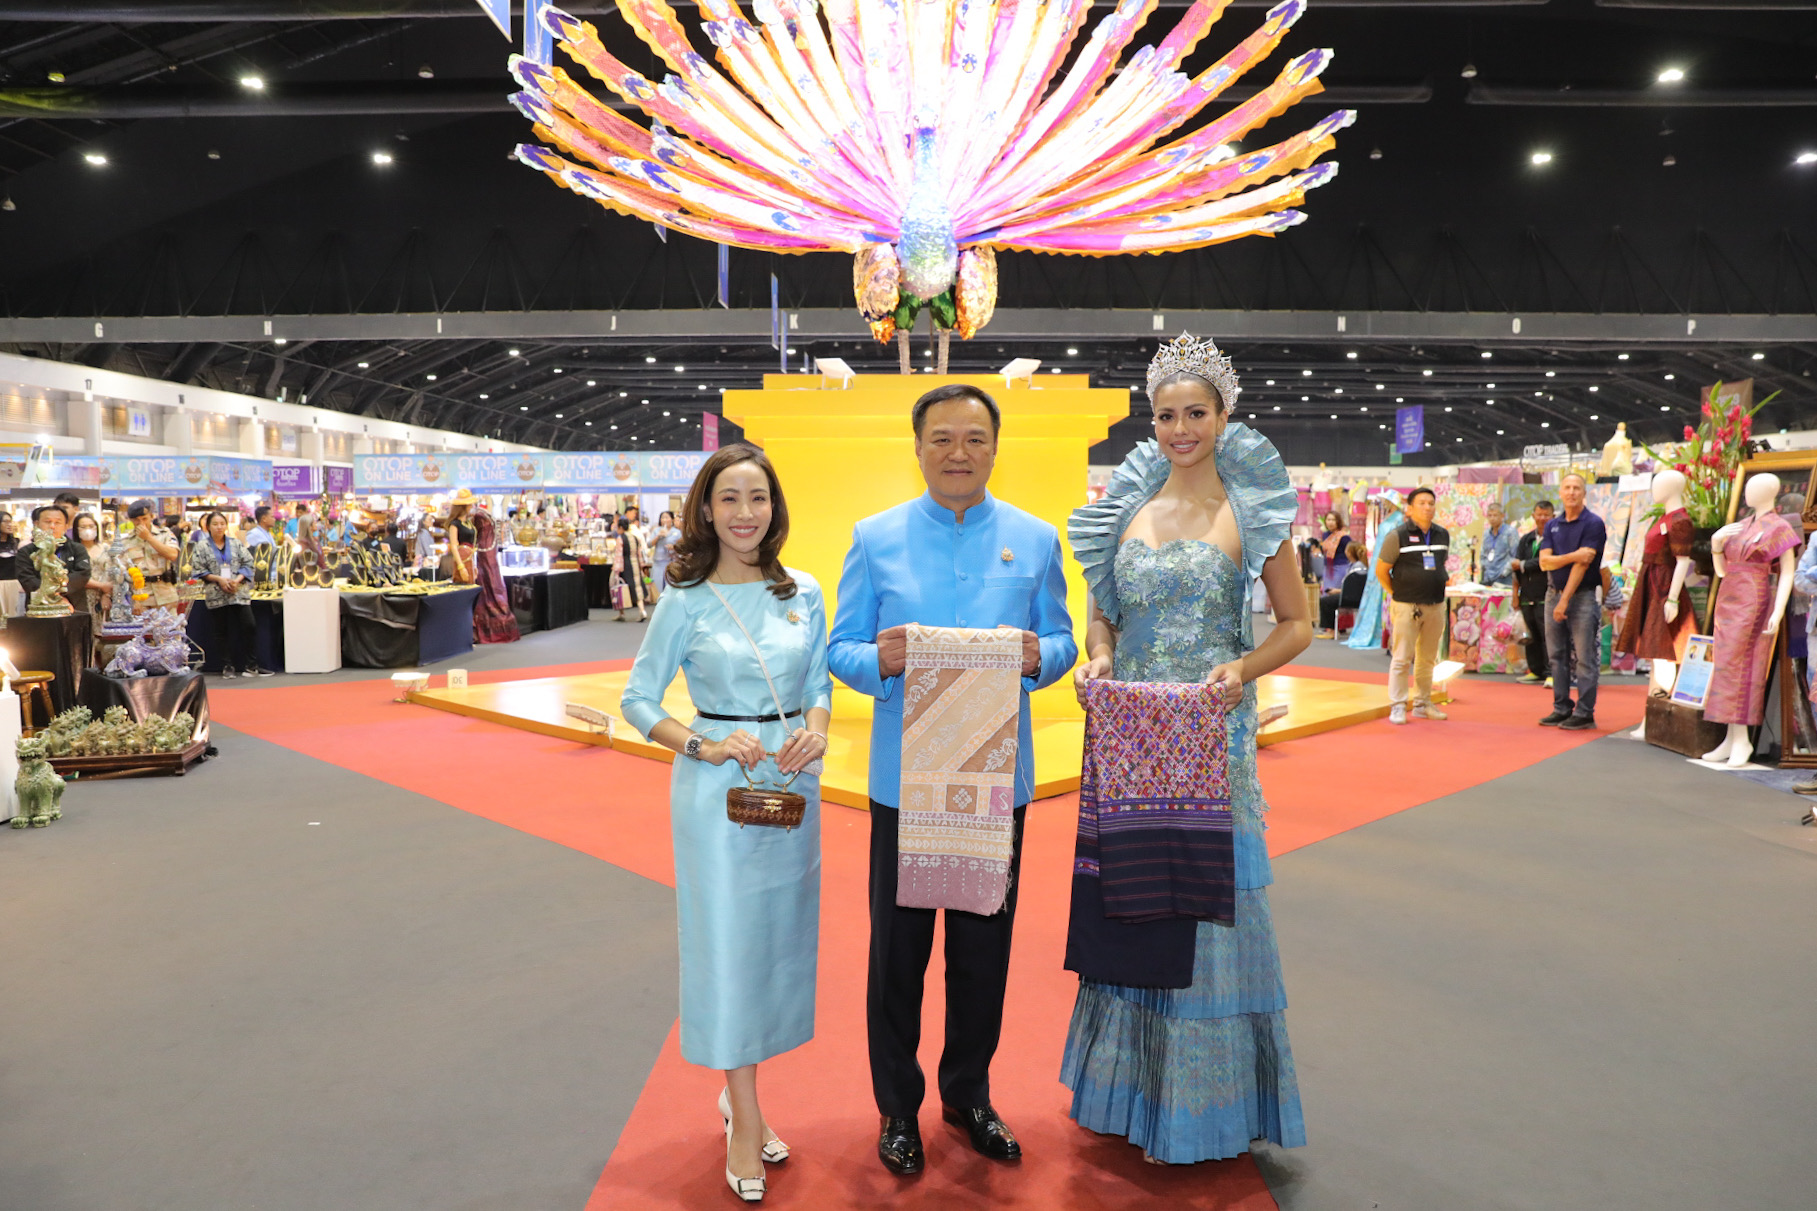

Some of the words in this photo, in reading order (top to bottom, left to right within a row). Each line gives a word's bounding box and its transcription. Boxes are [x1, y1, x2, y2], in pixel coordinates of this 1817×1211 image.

[264, 320, 272, 336] H
[611, 315, 616, 331] J
[790, 314, 798, 329] K
[1153, 314, 1164, 330] M
[1337, 316, 1346, 332] N
[1512, 318, 1521, 334] O
[1687, 319, 1696, 335] P
[95, 322, 103, 338] G
[127, 459, 176, 473] OTOP
[363, 457, 413, 471] OTOP
[457, 456, 508, 470] OTOP
[553, 455, 604, 470] OTOP
[650, 455, 701, 469] OTOP
[129, 472, 146, 482] ON
[150, 472, 174, 482] LINE
[273, 468, 300, 477] OTOP
[364, 471, 380, 481] ON
[386, 471, 411, 480] LINE
[459, 471, 476, 480] ON
[481, 471, 506, 480] LINE
[554, 470, 571, 480] ON
[576, 470, 602, 479] LINE
[651, 470, 668, 479] ON
